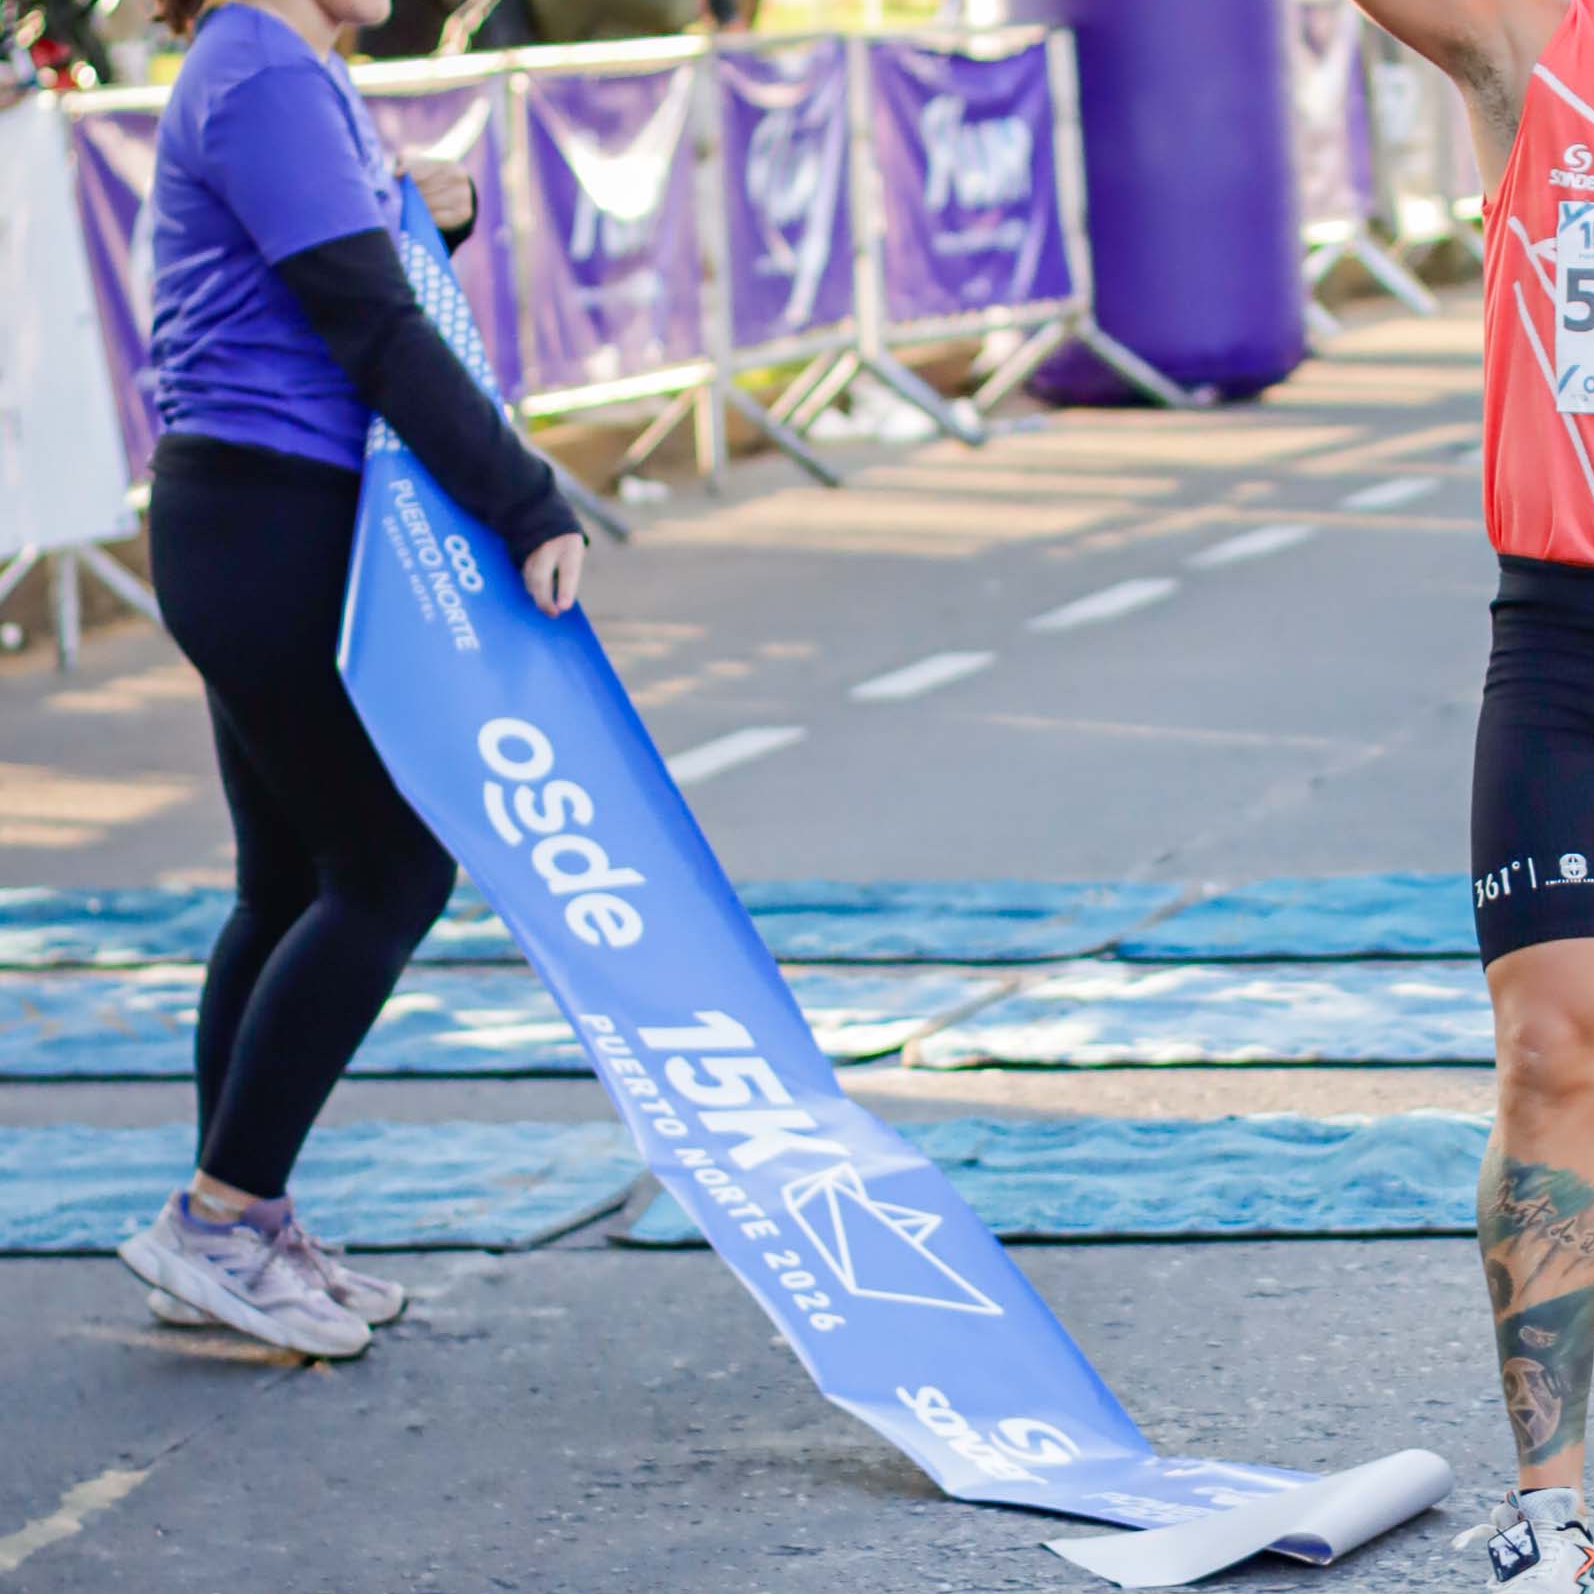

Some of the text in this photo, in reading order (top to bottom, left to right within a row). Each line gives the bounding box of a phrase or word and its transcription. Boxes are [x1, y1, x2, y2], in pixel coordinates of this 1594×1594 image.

[388, 478, 481, 651] PUERTO NORTE
[477, 717, 647, 948] osde
[578, 1014, 847, 1333] PUERTO NORTE 2026
[637, 1010, 852, 1171] 15K
